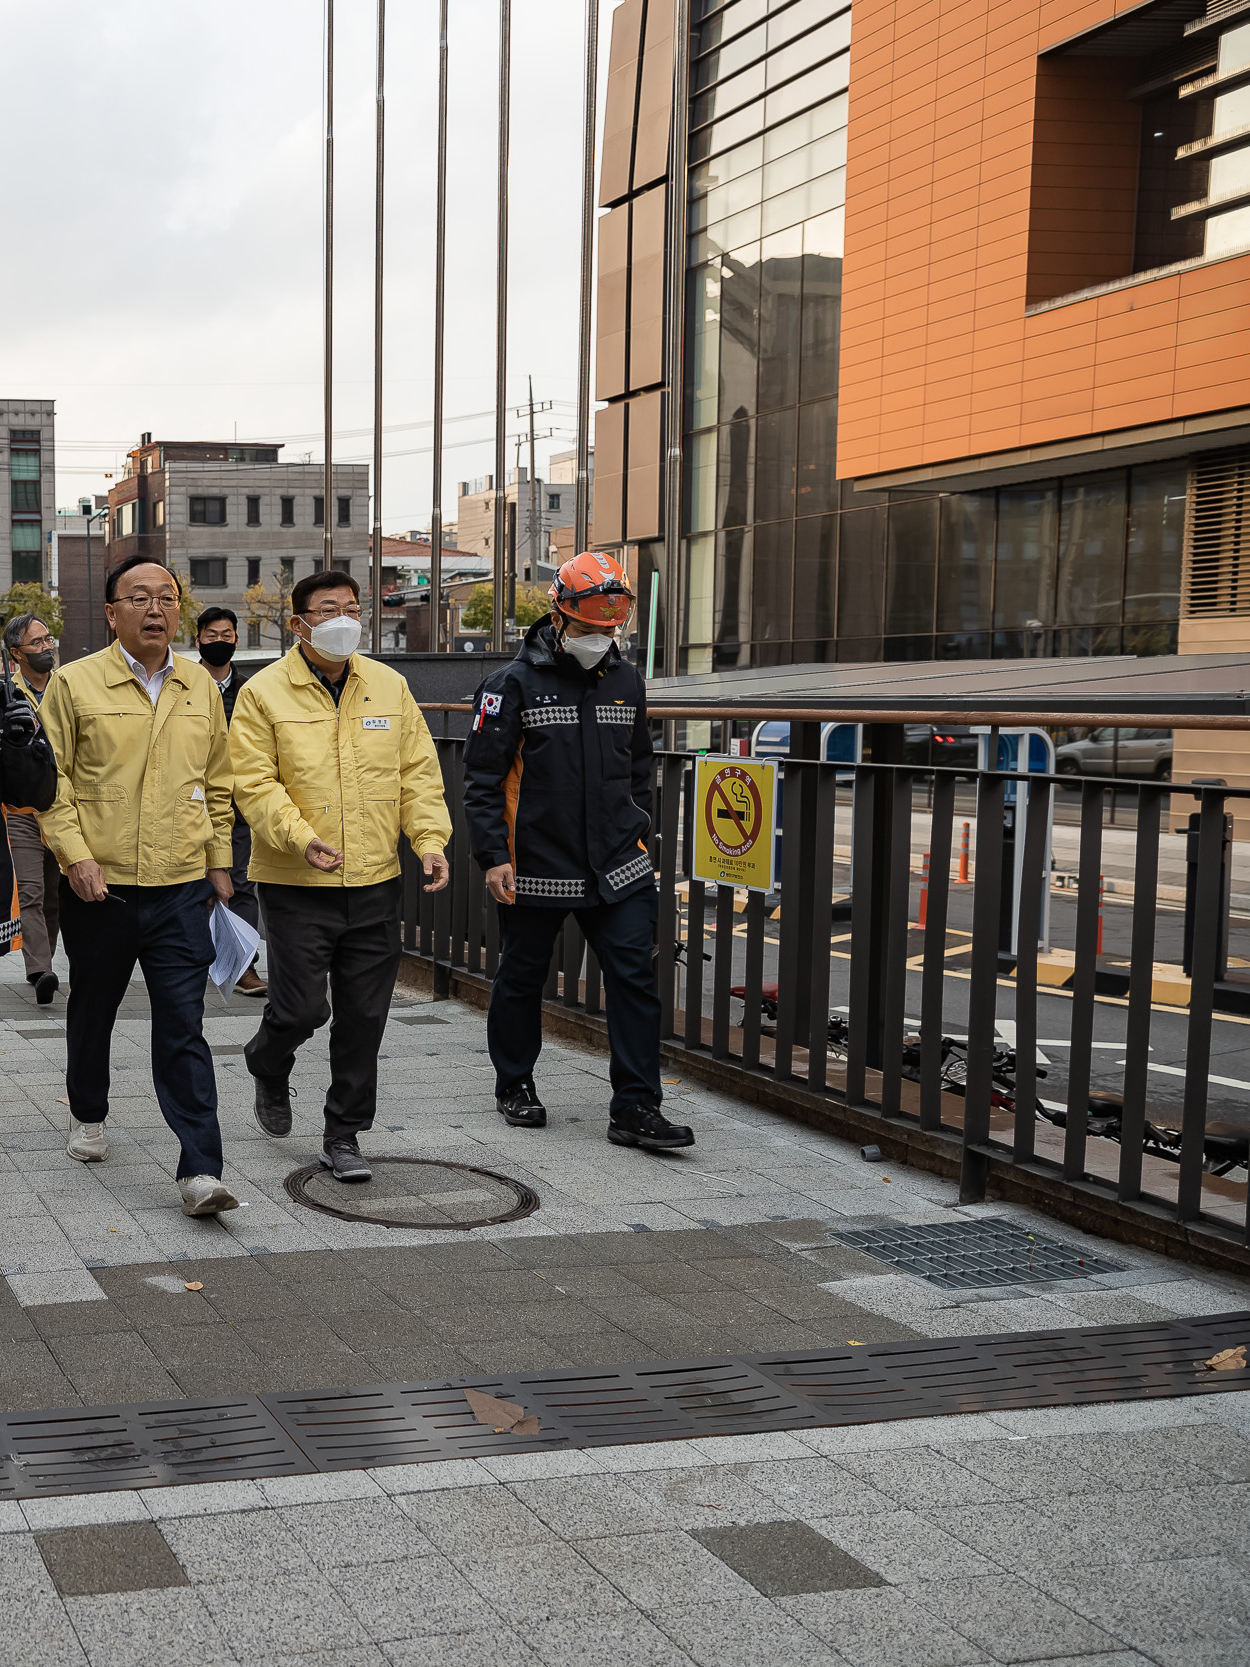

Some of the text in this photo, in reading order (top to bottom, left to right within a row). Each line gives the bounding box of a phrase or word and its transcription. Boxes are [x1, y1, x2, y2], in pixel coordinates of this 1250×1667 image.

[714, 767, 752, 786] 금연구역
[712, 833, 753, 856] No Smoking Area
